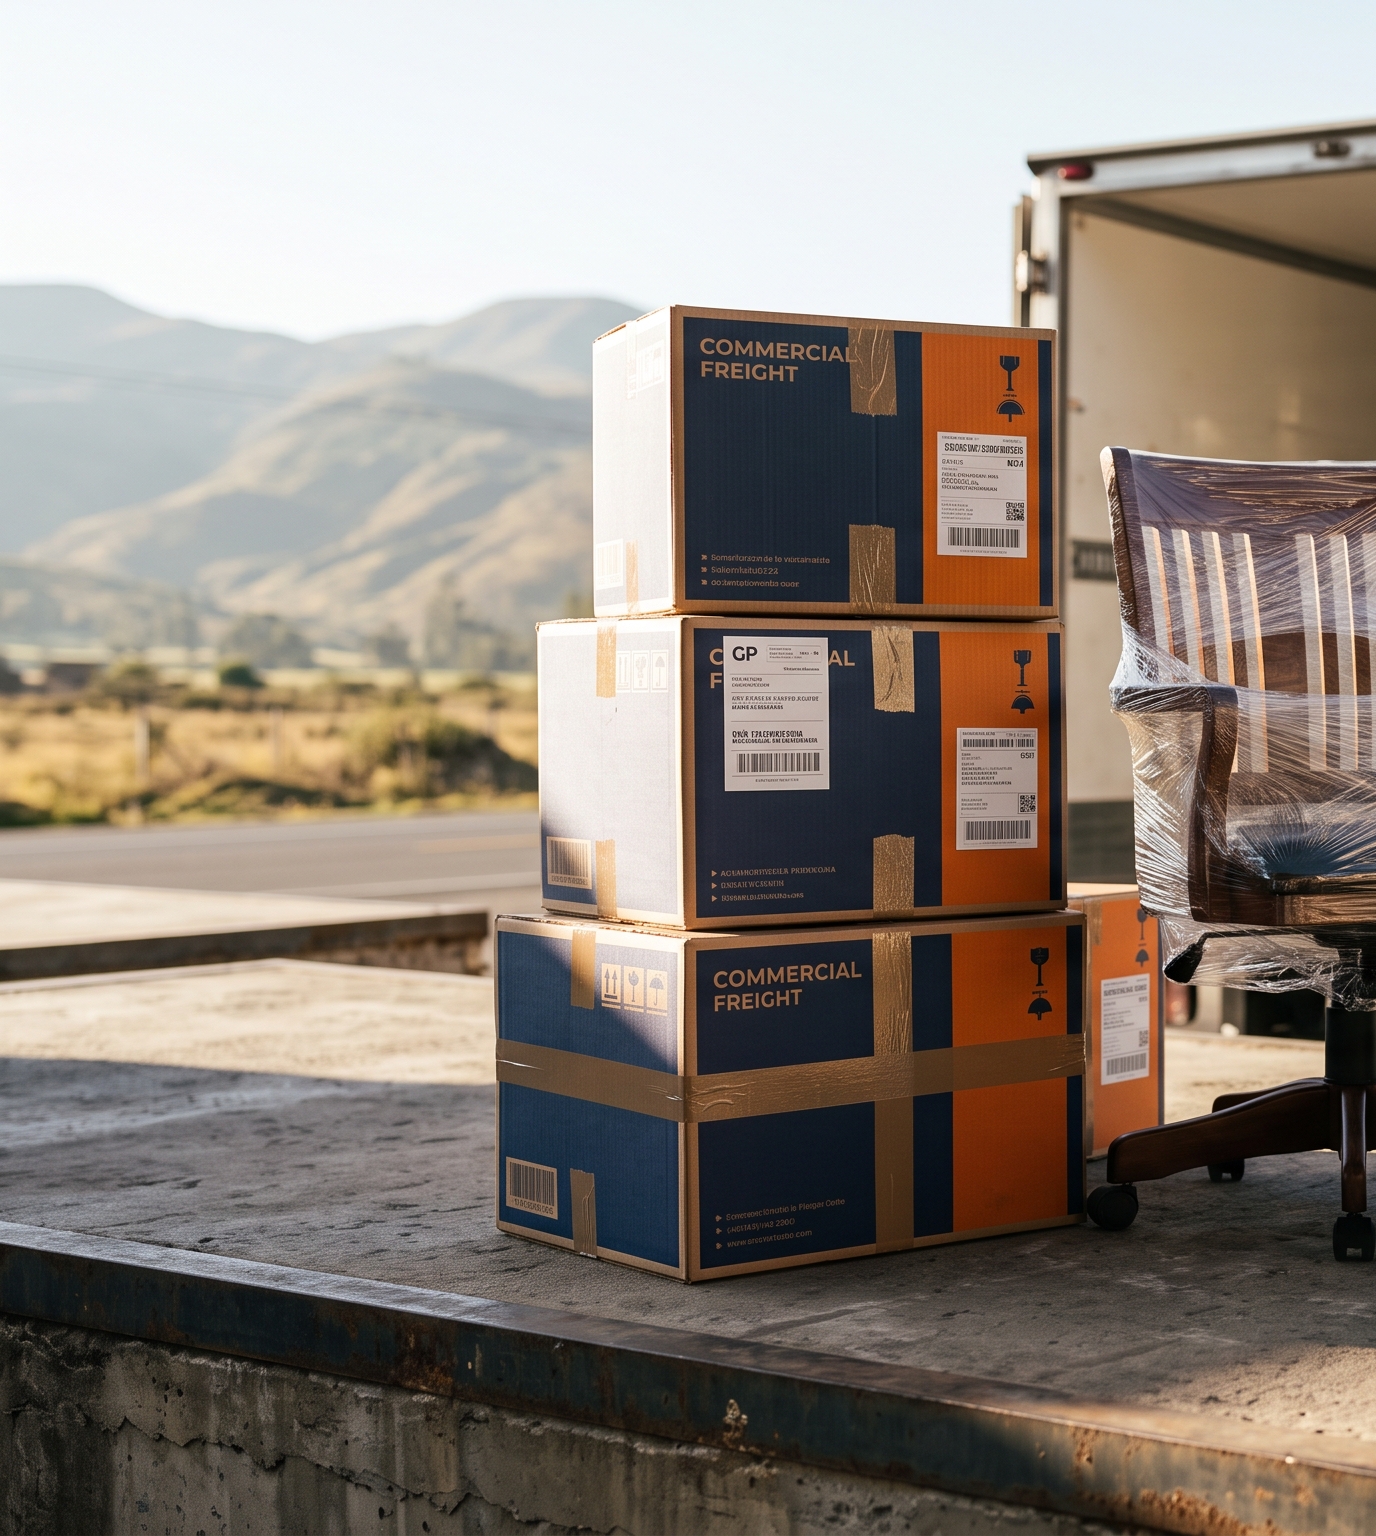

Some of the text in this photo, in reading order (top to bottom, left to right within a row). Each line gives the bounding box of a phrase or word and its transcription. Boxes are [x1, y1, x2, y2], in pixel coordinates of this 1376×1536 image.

[700, 337, 858, 363] COMMERCIAL
[701, 361, 799, 382] FREIGHT
[732, 646, 758, 661] GP
[713, 961, 862, 989] COMMERCIAL
[714, 988, 803, 1012] FREIGHT
